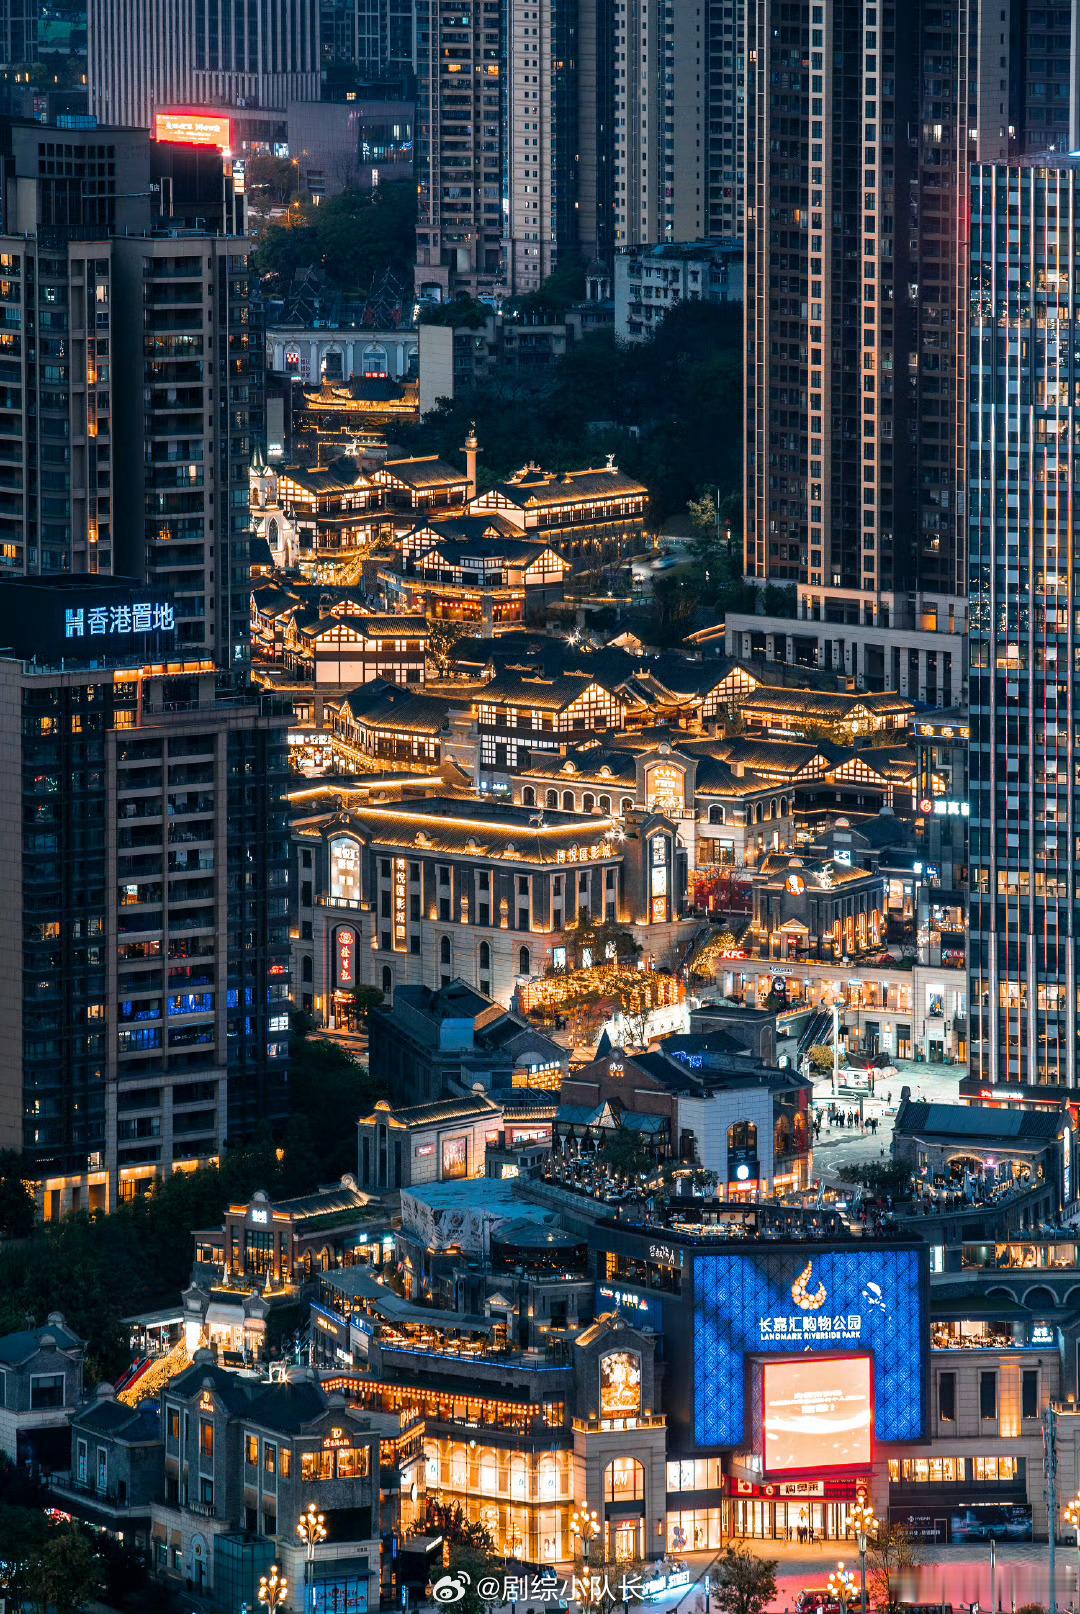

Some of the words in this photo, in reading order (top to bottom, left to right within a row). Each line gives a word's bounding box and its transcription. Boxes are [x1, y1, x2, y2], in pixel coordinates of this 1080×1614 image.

[87, 602, 175, 635] 香港置地
[722, 951, 745, 959] KFC
[759, 1315, 861, 1332] 长嘉汇购物公园
[761, 1332, 802, 1341] LANDMARK
[804, 1331, 841, 1340] RIVERSIDE
[842, 1331, 861, 1339] PARK
